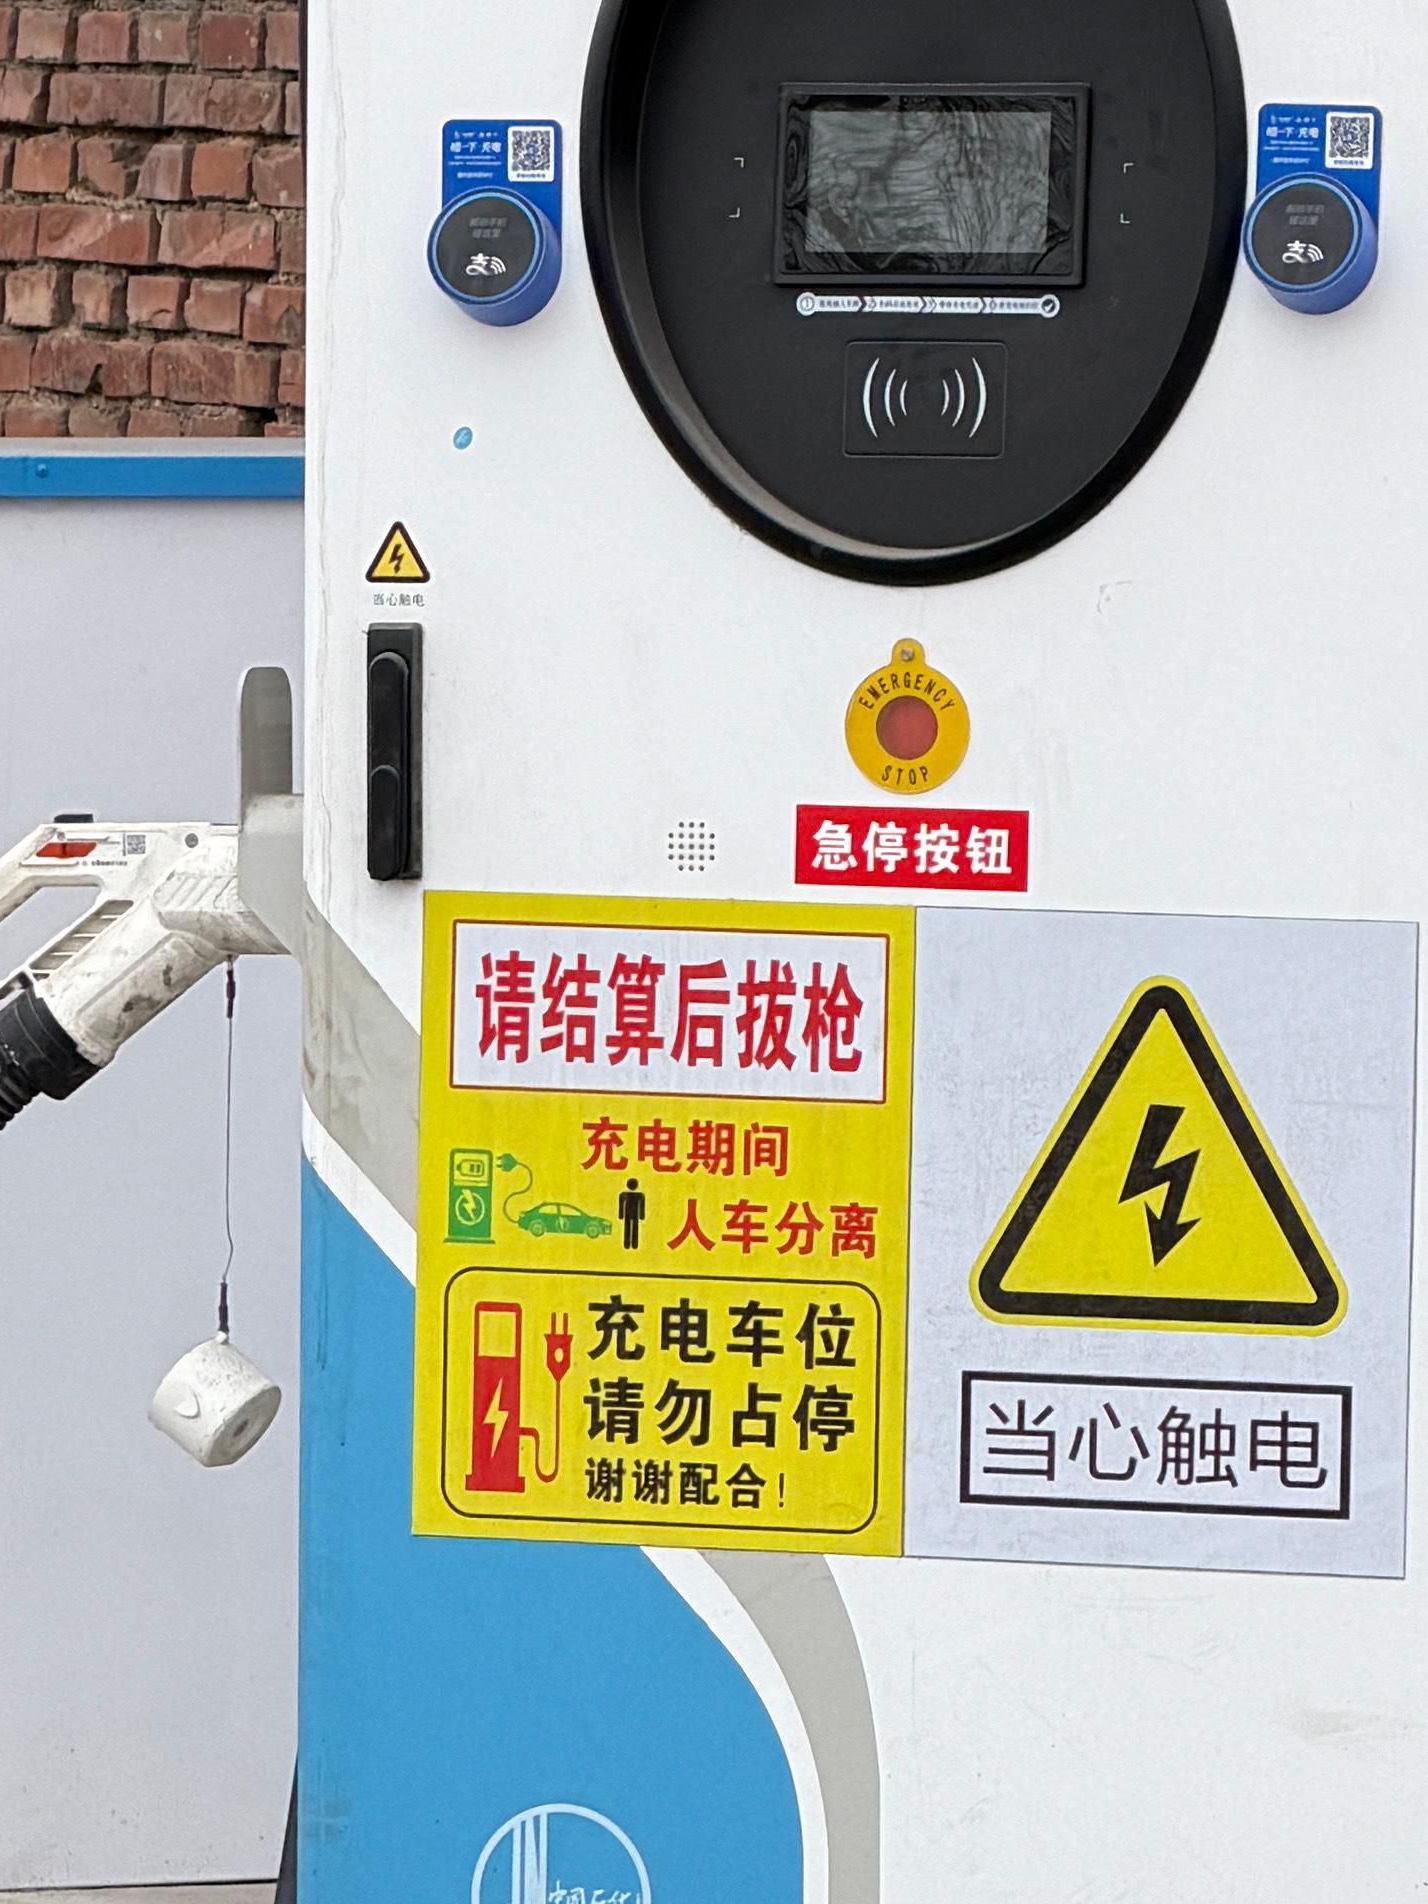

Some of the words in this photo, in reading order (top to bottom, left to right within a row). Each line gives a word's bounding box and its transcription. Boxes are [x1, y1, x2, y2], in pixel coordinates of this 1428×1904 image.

[373, 592, 425, 607] 当心触电
[858, 671, 955, 710] EMERGENCY
[881, 764, 930, 786] STOP
[811, 819, 1012, 875] 急停按钮
[475, 951, 865, 1074] 请结算后拔枪
[581, 1116, 789, 1177] 充电期间
[666, 1198, 879, 1259] 人车分离
[587, 1294, 857, 1370] 充电车位
[582, 1376, 855, 1453] 请勿占停
[982, 1399, 1328, 1490] 当心触电
[584, 1457, 785, 1509] 谢谢配合！
